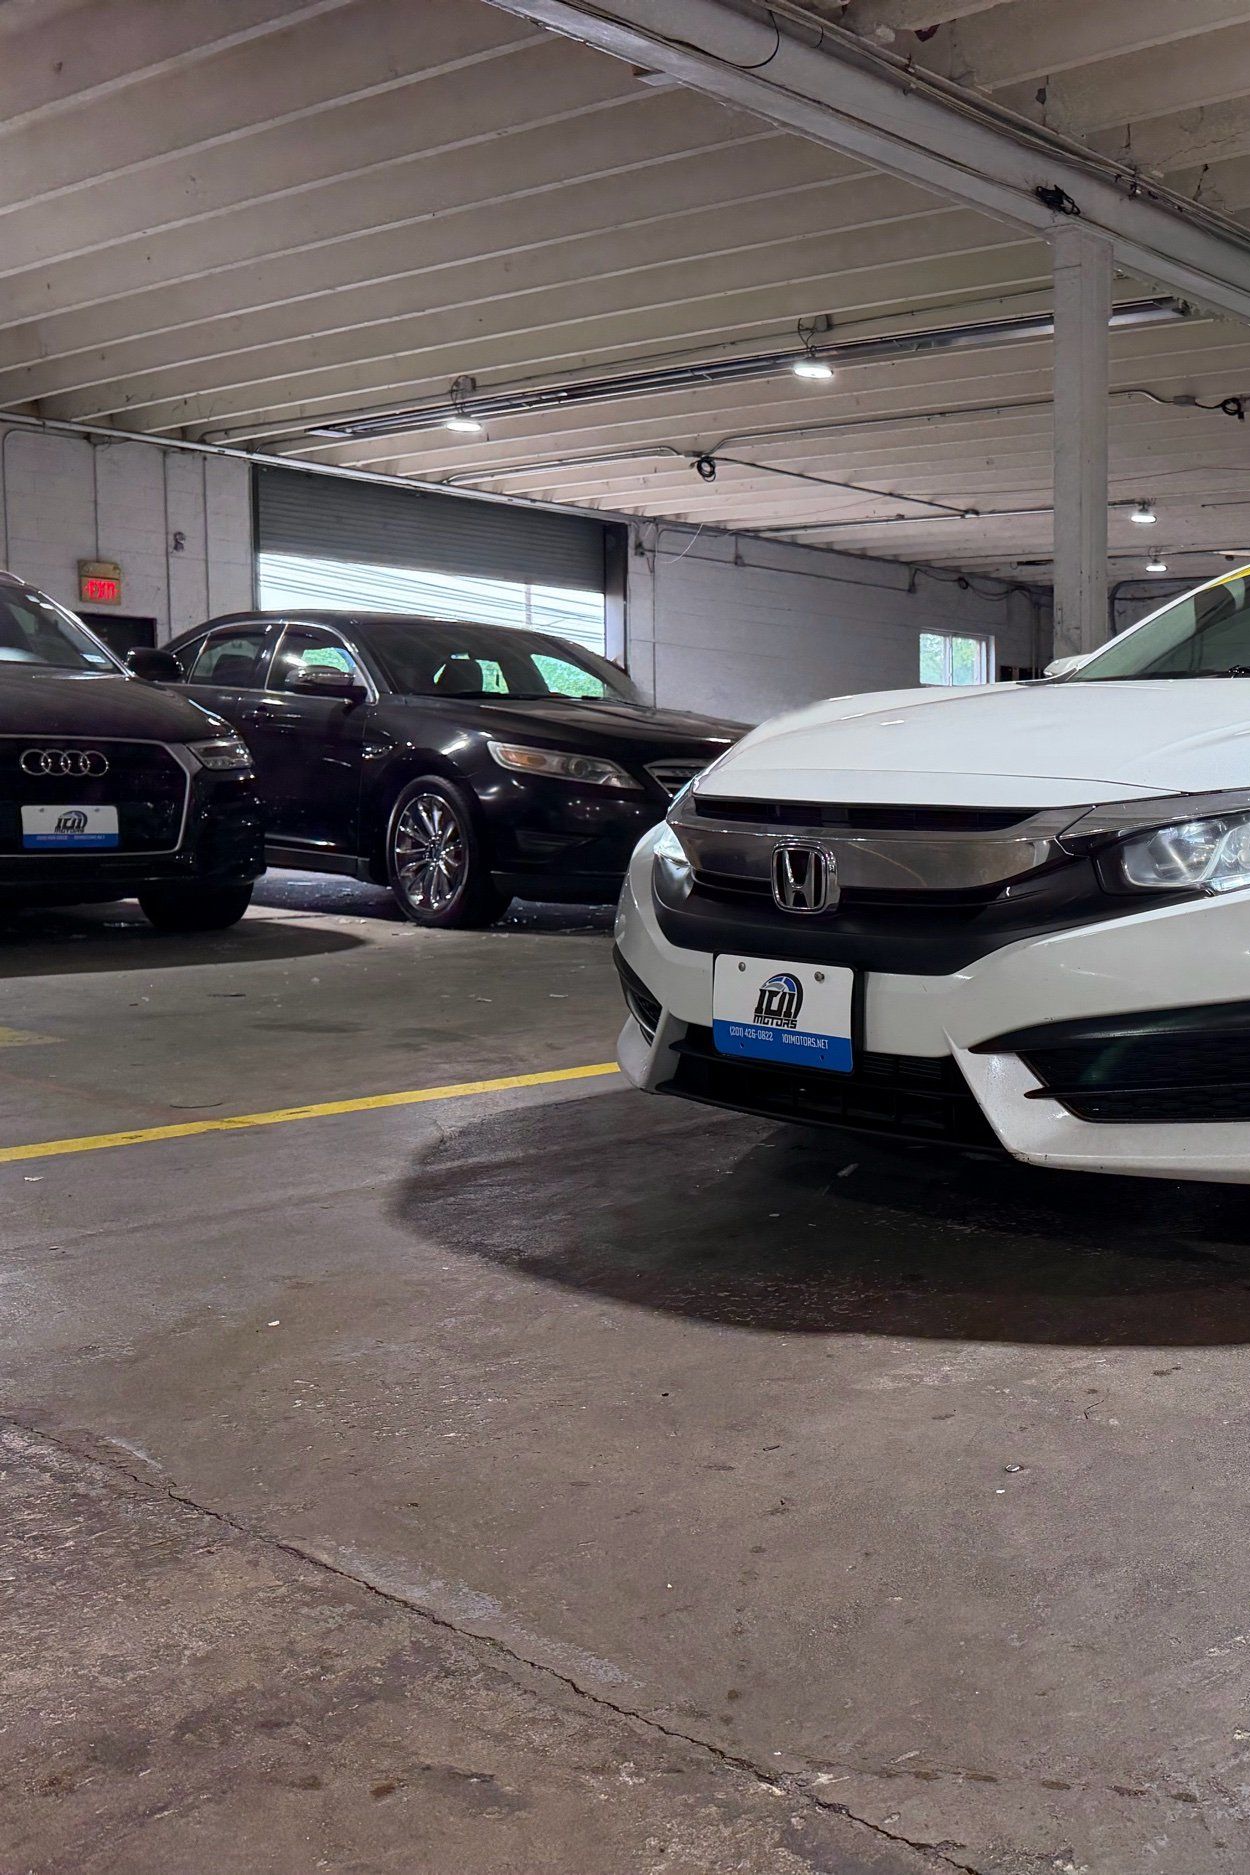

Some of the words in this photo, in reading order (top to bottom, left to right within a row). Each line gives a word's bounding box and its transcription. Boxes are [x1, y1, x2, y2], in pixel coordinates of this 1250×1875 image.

[753, 1014, 798, 1029] MOTORS
[729, 1026, 744, 1037] (201)
[744, 1028, 774, 1042] 426-0822
[781, 1033, 829, 1050] 101MOTORS.NET
